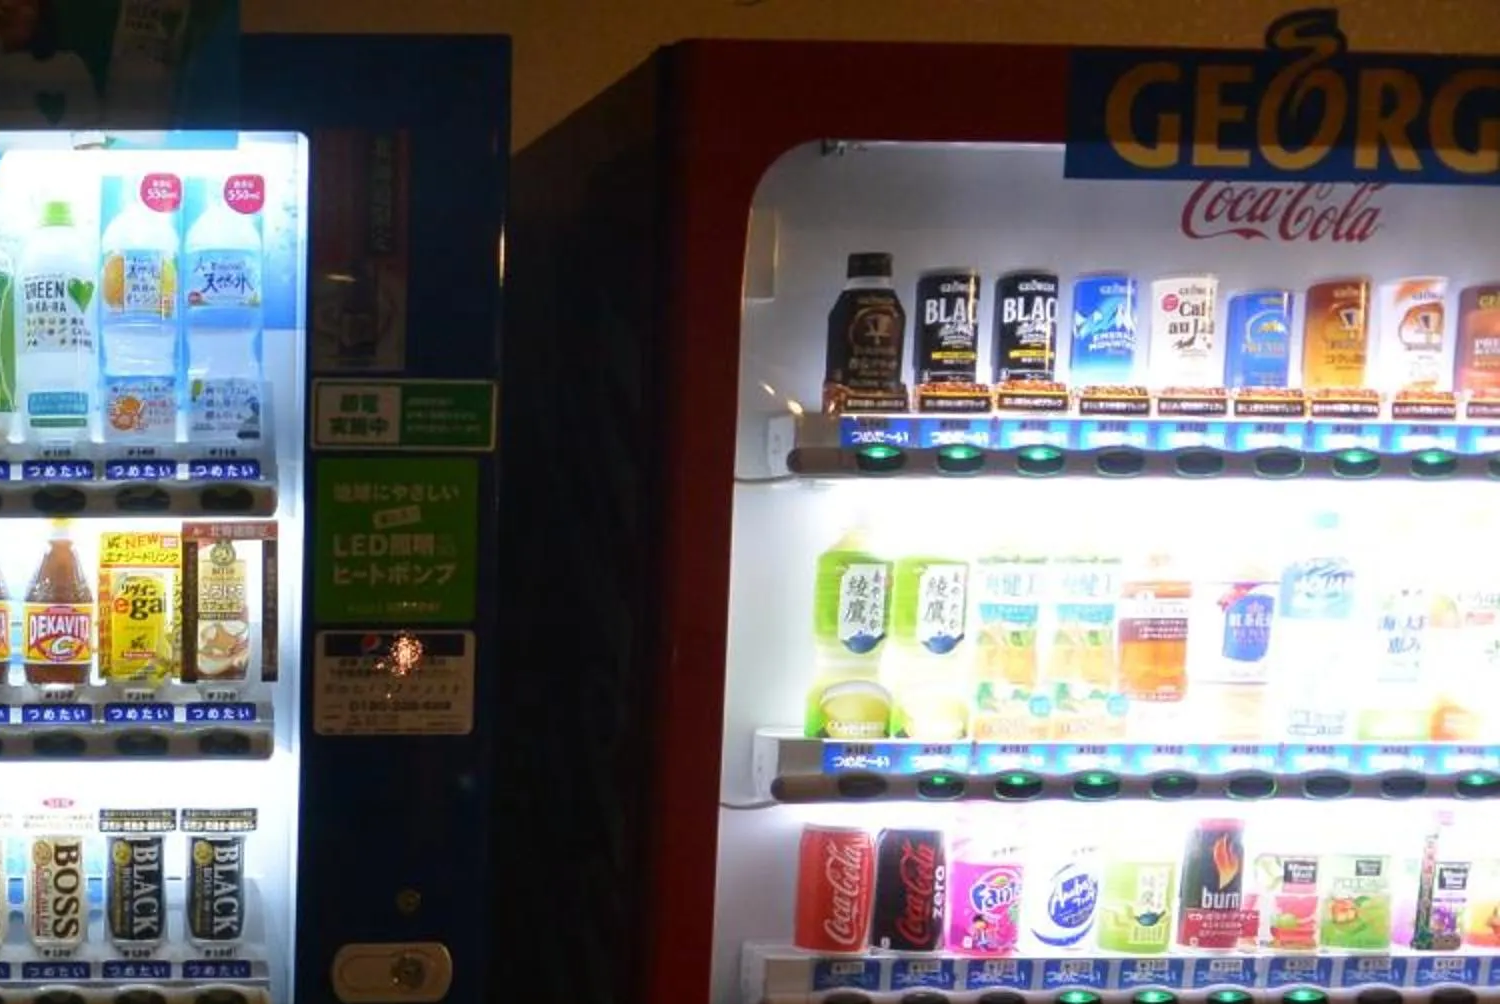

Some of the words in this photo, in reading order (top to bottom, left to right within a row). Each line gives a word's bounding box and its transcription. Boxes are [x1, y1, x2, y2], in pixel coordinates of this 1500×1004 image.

[27, 466, 88, 478] つめたい
[112, 464, 172, 477] つめたい
[195, 464, 254, 477] つめたい
[27, 709, 86, 721] つめたい
[111, 708, 169, 719] つめたい
[192, 708, 251, 719] つめたい
[53, 844, 80, 938] BOSS
[132, 844, 159, 934] BLACK
[213, 844, 239, 934] BLACK
[931, 865, 945, 919] zero
